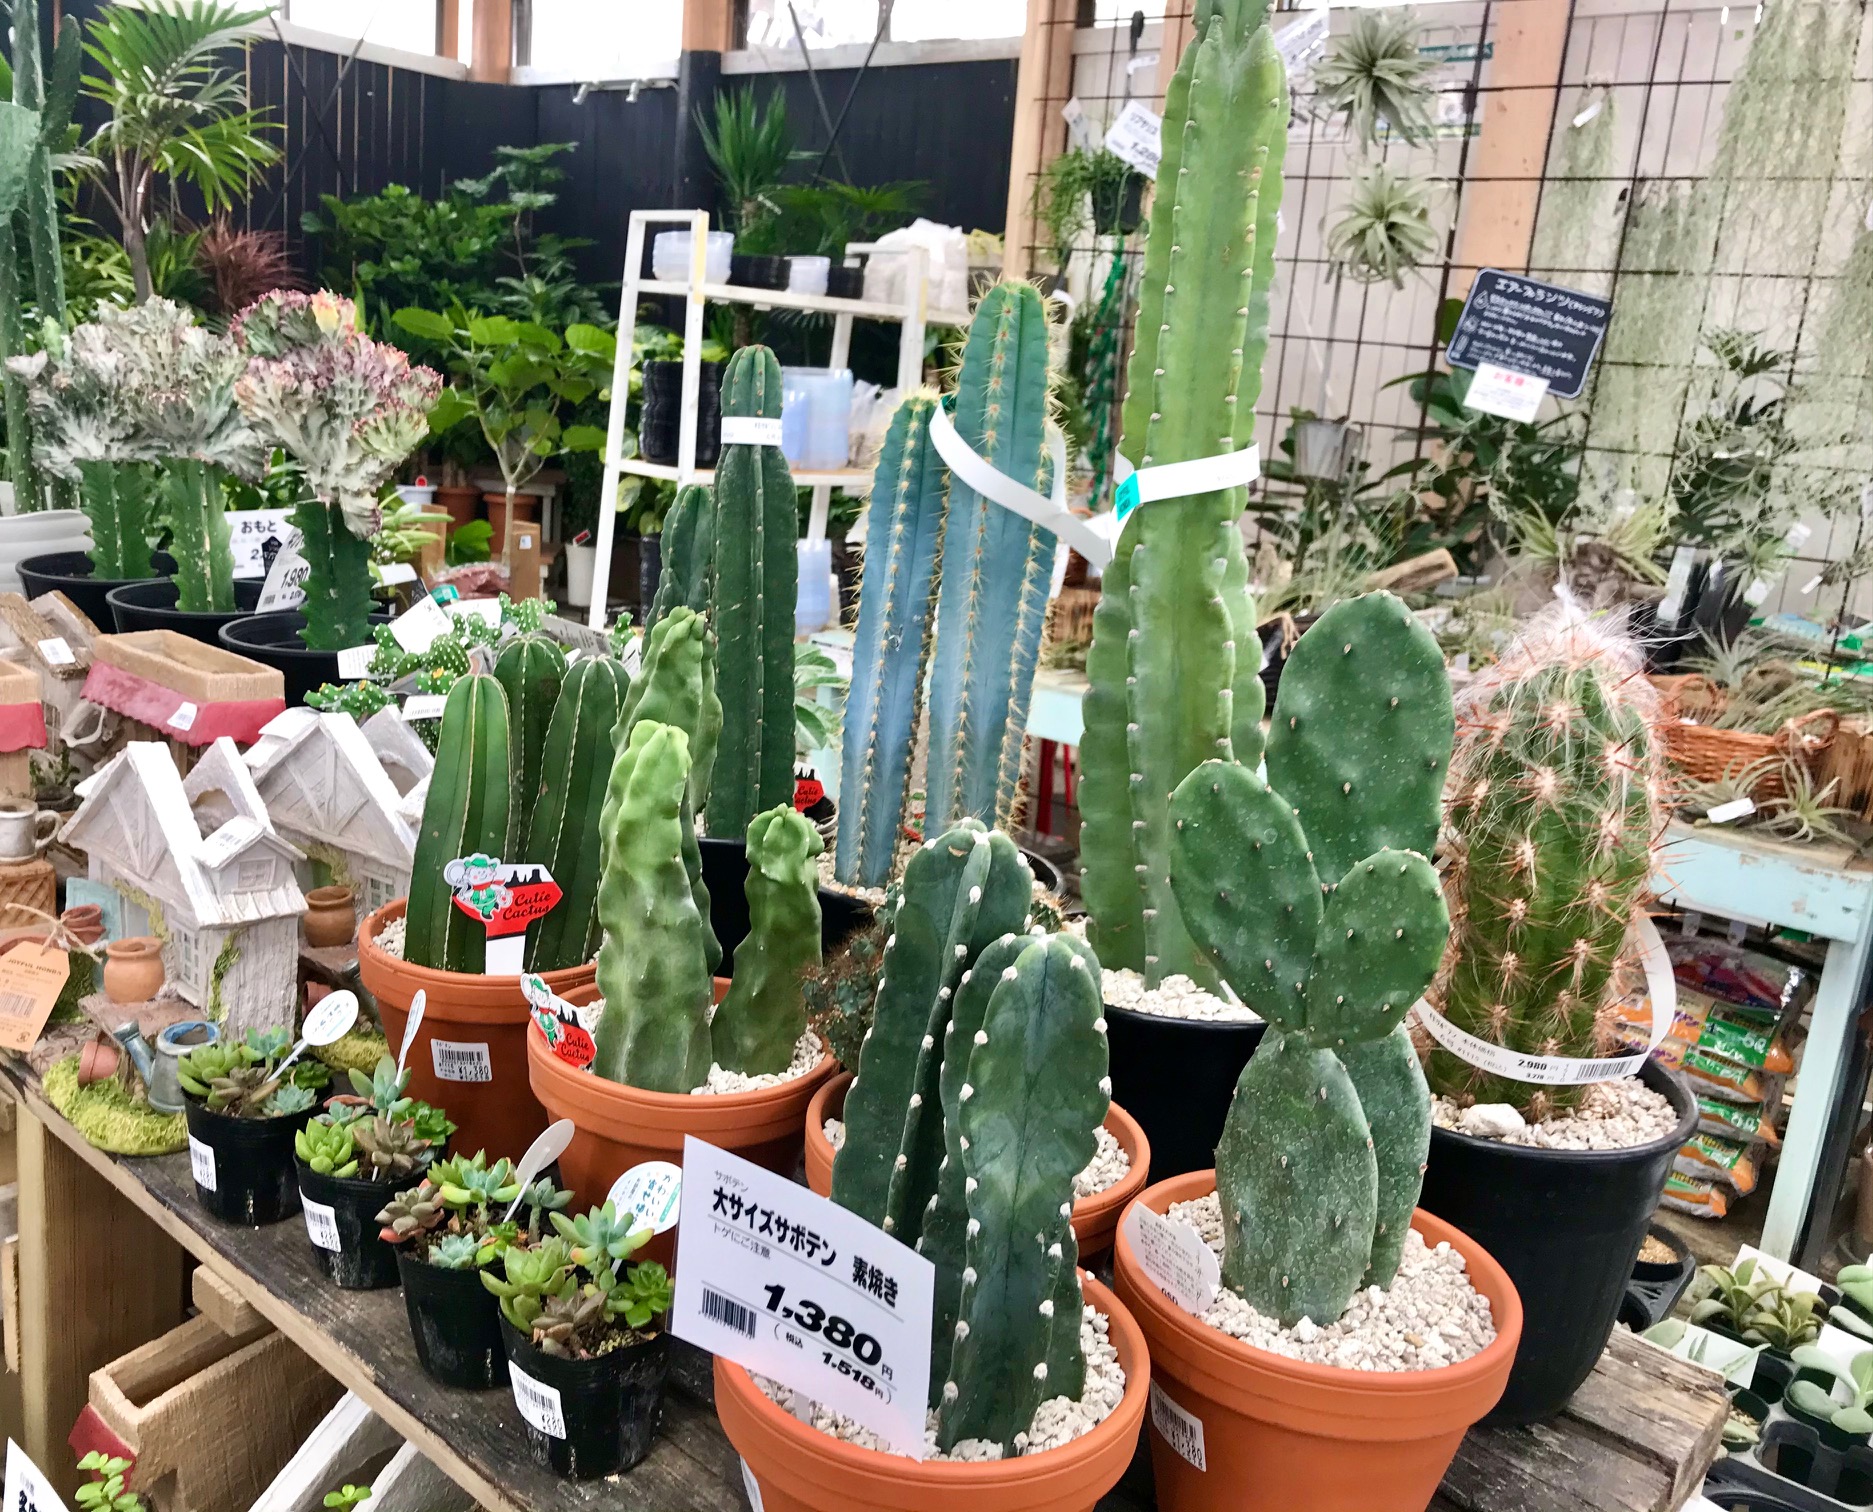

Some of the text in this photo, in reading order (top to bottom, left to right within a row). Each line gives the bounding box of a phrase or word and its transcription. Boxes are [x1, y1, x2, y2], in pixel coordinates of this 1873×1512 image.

[241, 520, 277, 534] おもと
[514, 890, 551, 908] Cutie
[502, 905, 550, 921] Cactus
[566, 1032, 590, 1050] Cutie
[560, 1043, 590, 1063] Cactus
[714, 1170, 749, 1193] サボテン
[648, 1174, 672, 1215] かわいい
[712, 1186, 837, 1266] 大サイズサボテン
[852, 1255, 899, 1309] 素焼き
[713, 1221, 771, 1261] トゲにご注意
